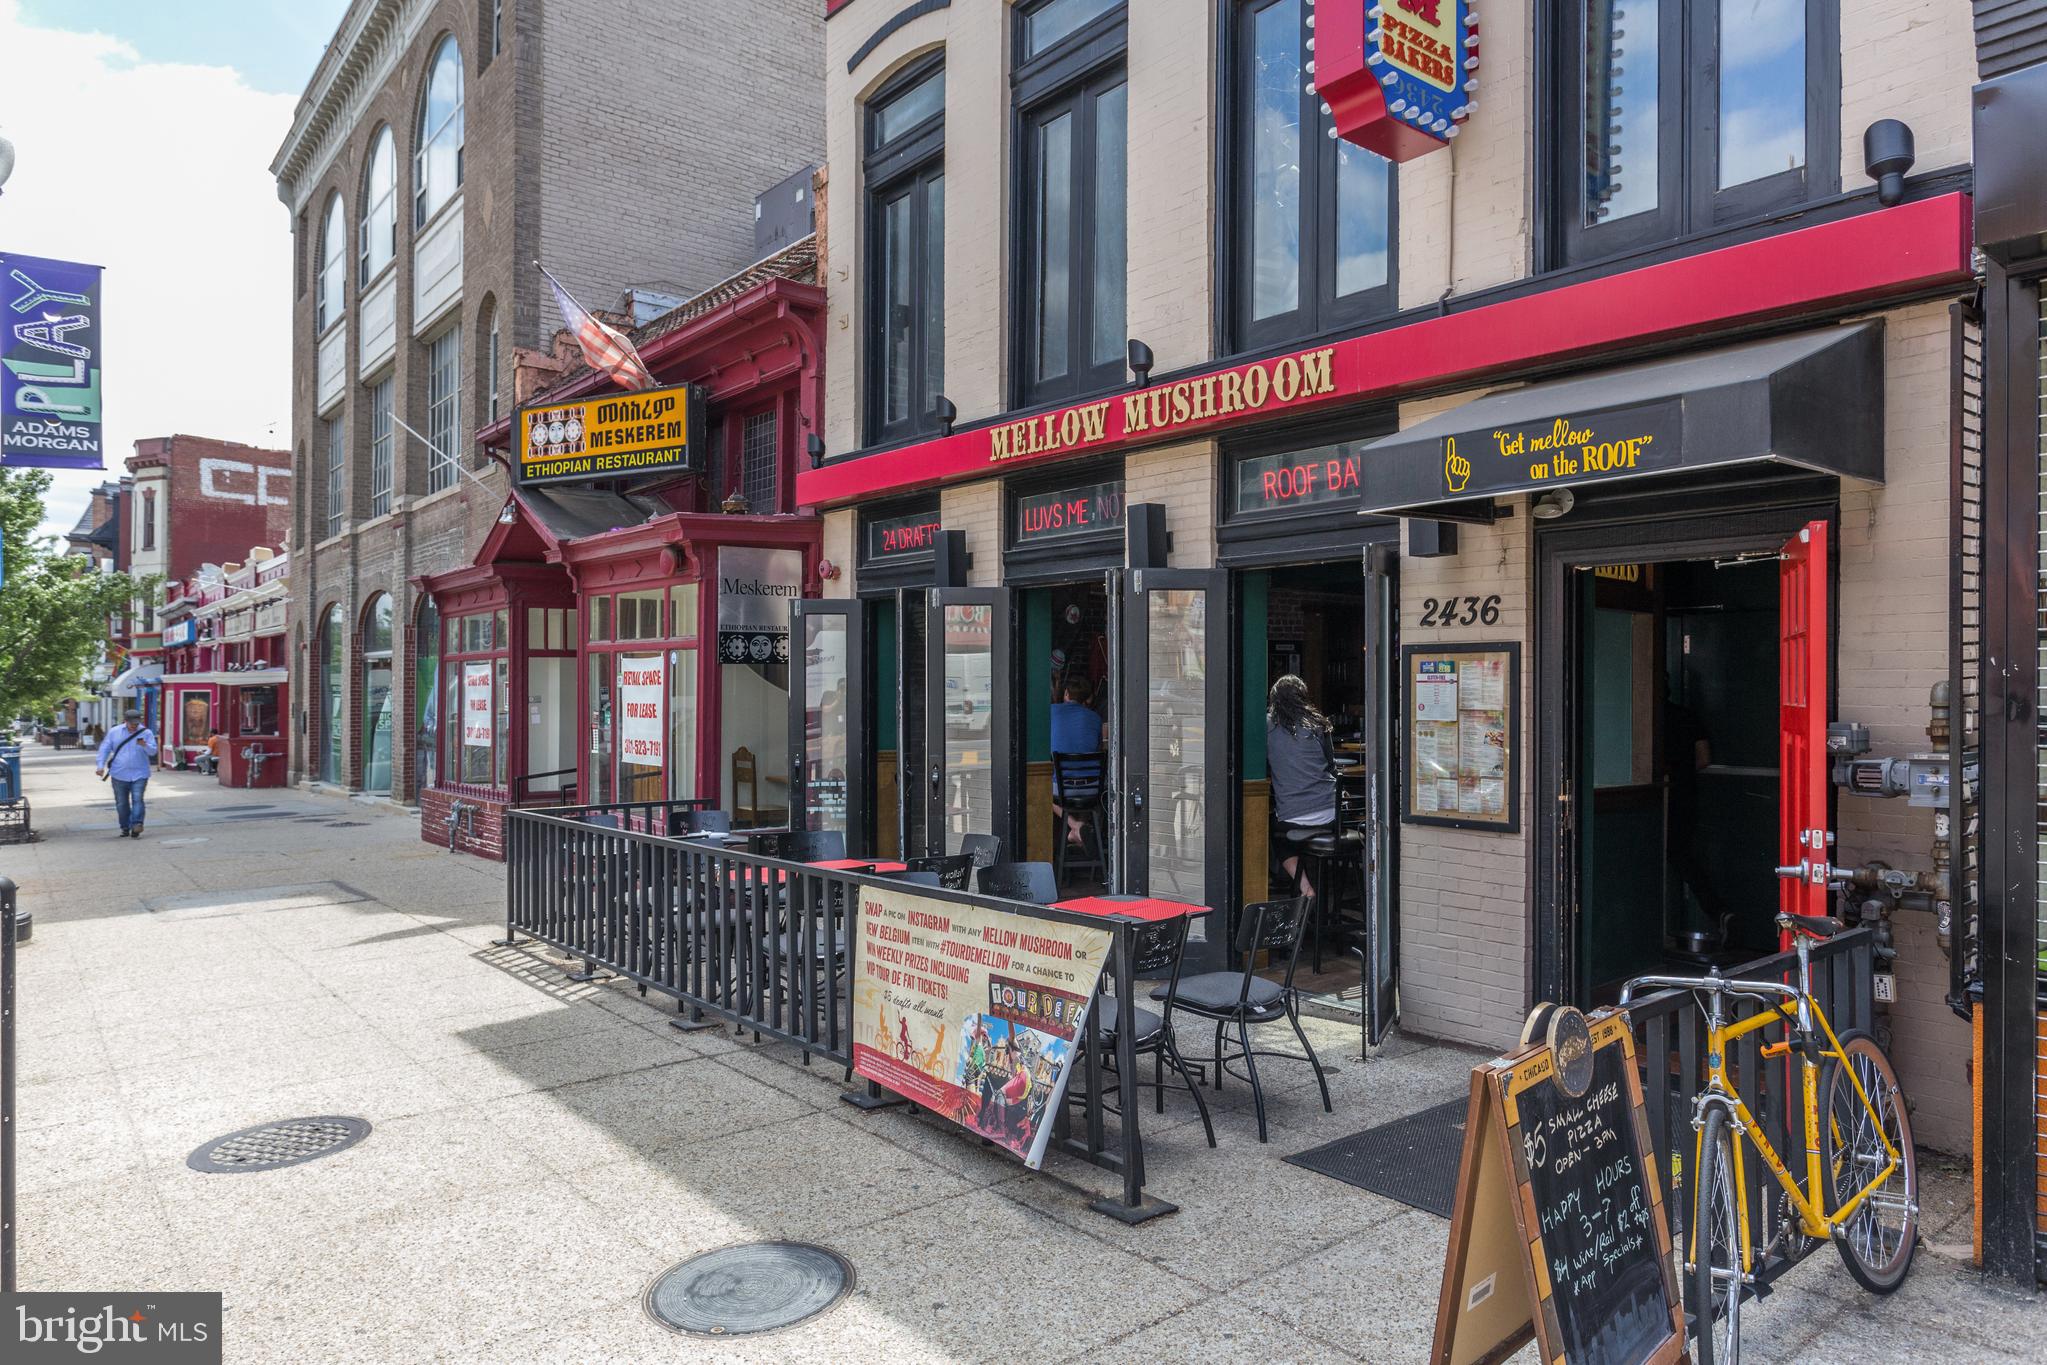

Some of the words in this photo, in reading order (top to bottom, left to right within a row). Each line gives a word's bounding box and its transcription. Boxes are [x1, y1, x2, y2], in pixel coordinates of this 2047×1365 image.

[1382, 12, 1454, 64] PIZZA
[1382, 33, 1454, 86] BAKERS
[10, 268, 91, 416] PLAY
[989, 401, 1109, 462] MELLOW
[1123, 348, 1335, 434] MUSHROOM
[3, 433, 98, 451] MORGAN
[12, 421, 90, 437] ADAMS
[590, 420, 681, 449] MESKEREM
[1530, 418, 1595, 452] mellow
[527, 460, 591, 478] ETHIOPIAN
[596, 448, 682, 471] RESTAURANT
[1263, 464, 1318, 500] ROOF
[1327, 455, 1360, 491] BA
[1530, 462, 1549, 480] on
[1553, 450, 1577, 478] the
[1025, 503, 1062, 531] LUVS
[883, 529, 897, 551] 24
[723, 577, 798, 597] Meskerem
[1419, 594, 1502, 627] 2436
[720, 623, 758, 632] ETHIOPIAN
[641, 670, 661, 685] SPACE
[626, 702, 638, 718] FOR
[639, 703, 657, 718] LEASE
[864, 901, 883, 918] SNAP
[889, 911, 897, 919] PIC
[897, 912, 906, 920] ON
[908, 910, 950, 933] INSTAGRAM
[952, 923, 966, 934] WITH
[967, 927, 982, 937] ANY
[983, 925, 1018, 948] MELLOW
[1020, 933, 1072, 960] MUSHROOM
[1075, 950, 1087, 960] OR
[866, 921, 878, 937] NEW
[879, 924, 911, 946] BELGIUM
[925, 940, 940, 950] WITH
[940, 939, 1011, 971] #TOURDEMELLOW
[1011, 960, 1024, 971] FOR
[1025, 965, 1031, 973] A
[1033, 965, 1063, 980] CHANCE
[1065, 972, 1075, 982] TO
[866, 940, 876, 957] WIN
[876, 944, 904, 966] WEEKLY
[904, 952, 929, 973] PRIZES
[930, 958, 970, 984] INCLUDING
[866, 959, 876, 976] VIP
[876, 964, 890, 983] TOUR
[891, 970, 902, 986] DE
[903, 973, 915, 990] FAT
[917, 976, 949, 1000] TICKETS!
[892, 995, 911, 1010] drafts
[912, 1000, 927, 1013] all
[923, 1007, 946, 1019] month
[991, 983, 1038, 1015] TOUR
[1041, 993, 1064, 1018] DE
[1548, 1109, 1583, 1134] SMALL
[1586, 1081, 1619, 1113] CHEESE
[1524, 1121, 1547, 1170] $5
[1567, 1116, 1603, 1148] PIZZA
[1593, 1127, 1617, 1149] 3PM
[1541, 1187, 1582, 1234] HAPPY
[1595, 1155, 1632, 1195] HOURS
[1630, 1184, 1641, 1212] off
